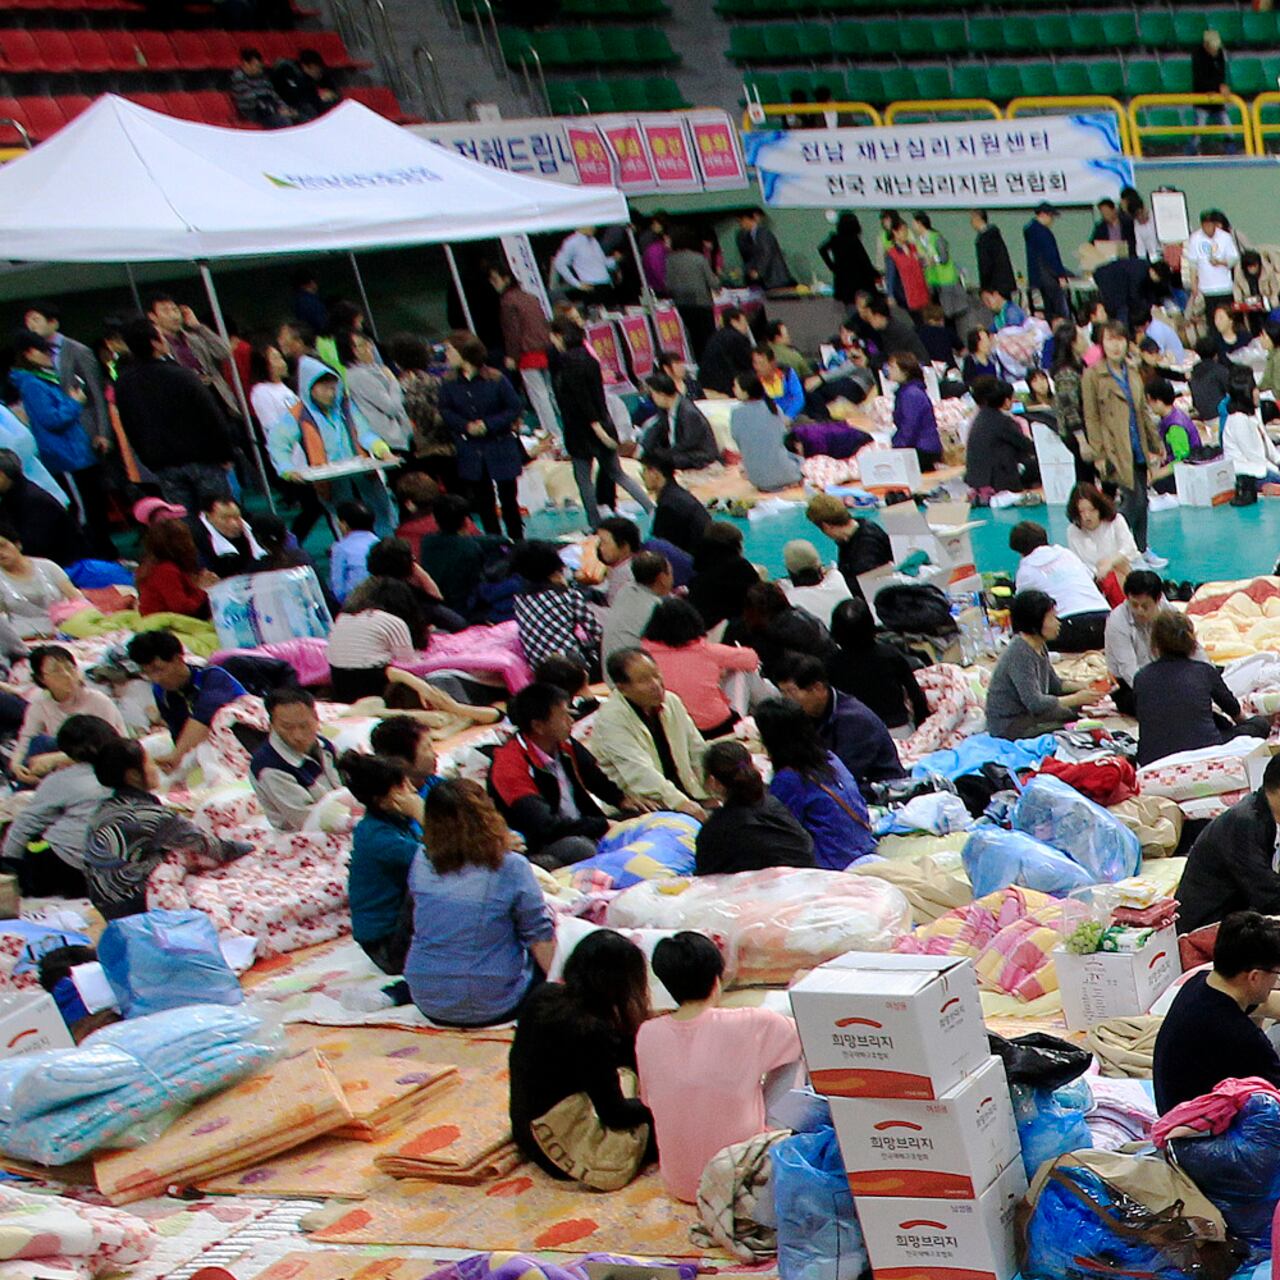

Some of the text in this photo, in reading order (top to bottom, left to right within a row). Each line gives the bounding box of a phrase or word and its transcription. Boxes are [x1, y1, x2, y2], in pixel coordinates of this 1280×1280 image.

[801, 129, 1050, 163] 전남 재난심리지원센터
[825, 170, 1068, 197] 전국 재난심리지원 연합회
[832, 1032, 894, 1050] 희망브리지
[870, 1136, 934, 1151] 희망브리지
[895, 1235, 958, 1249] 희망브리지
